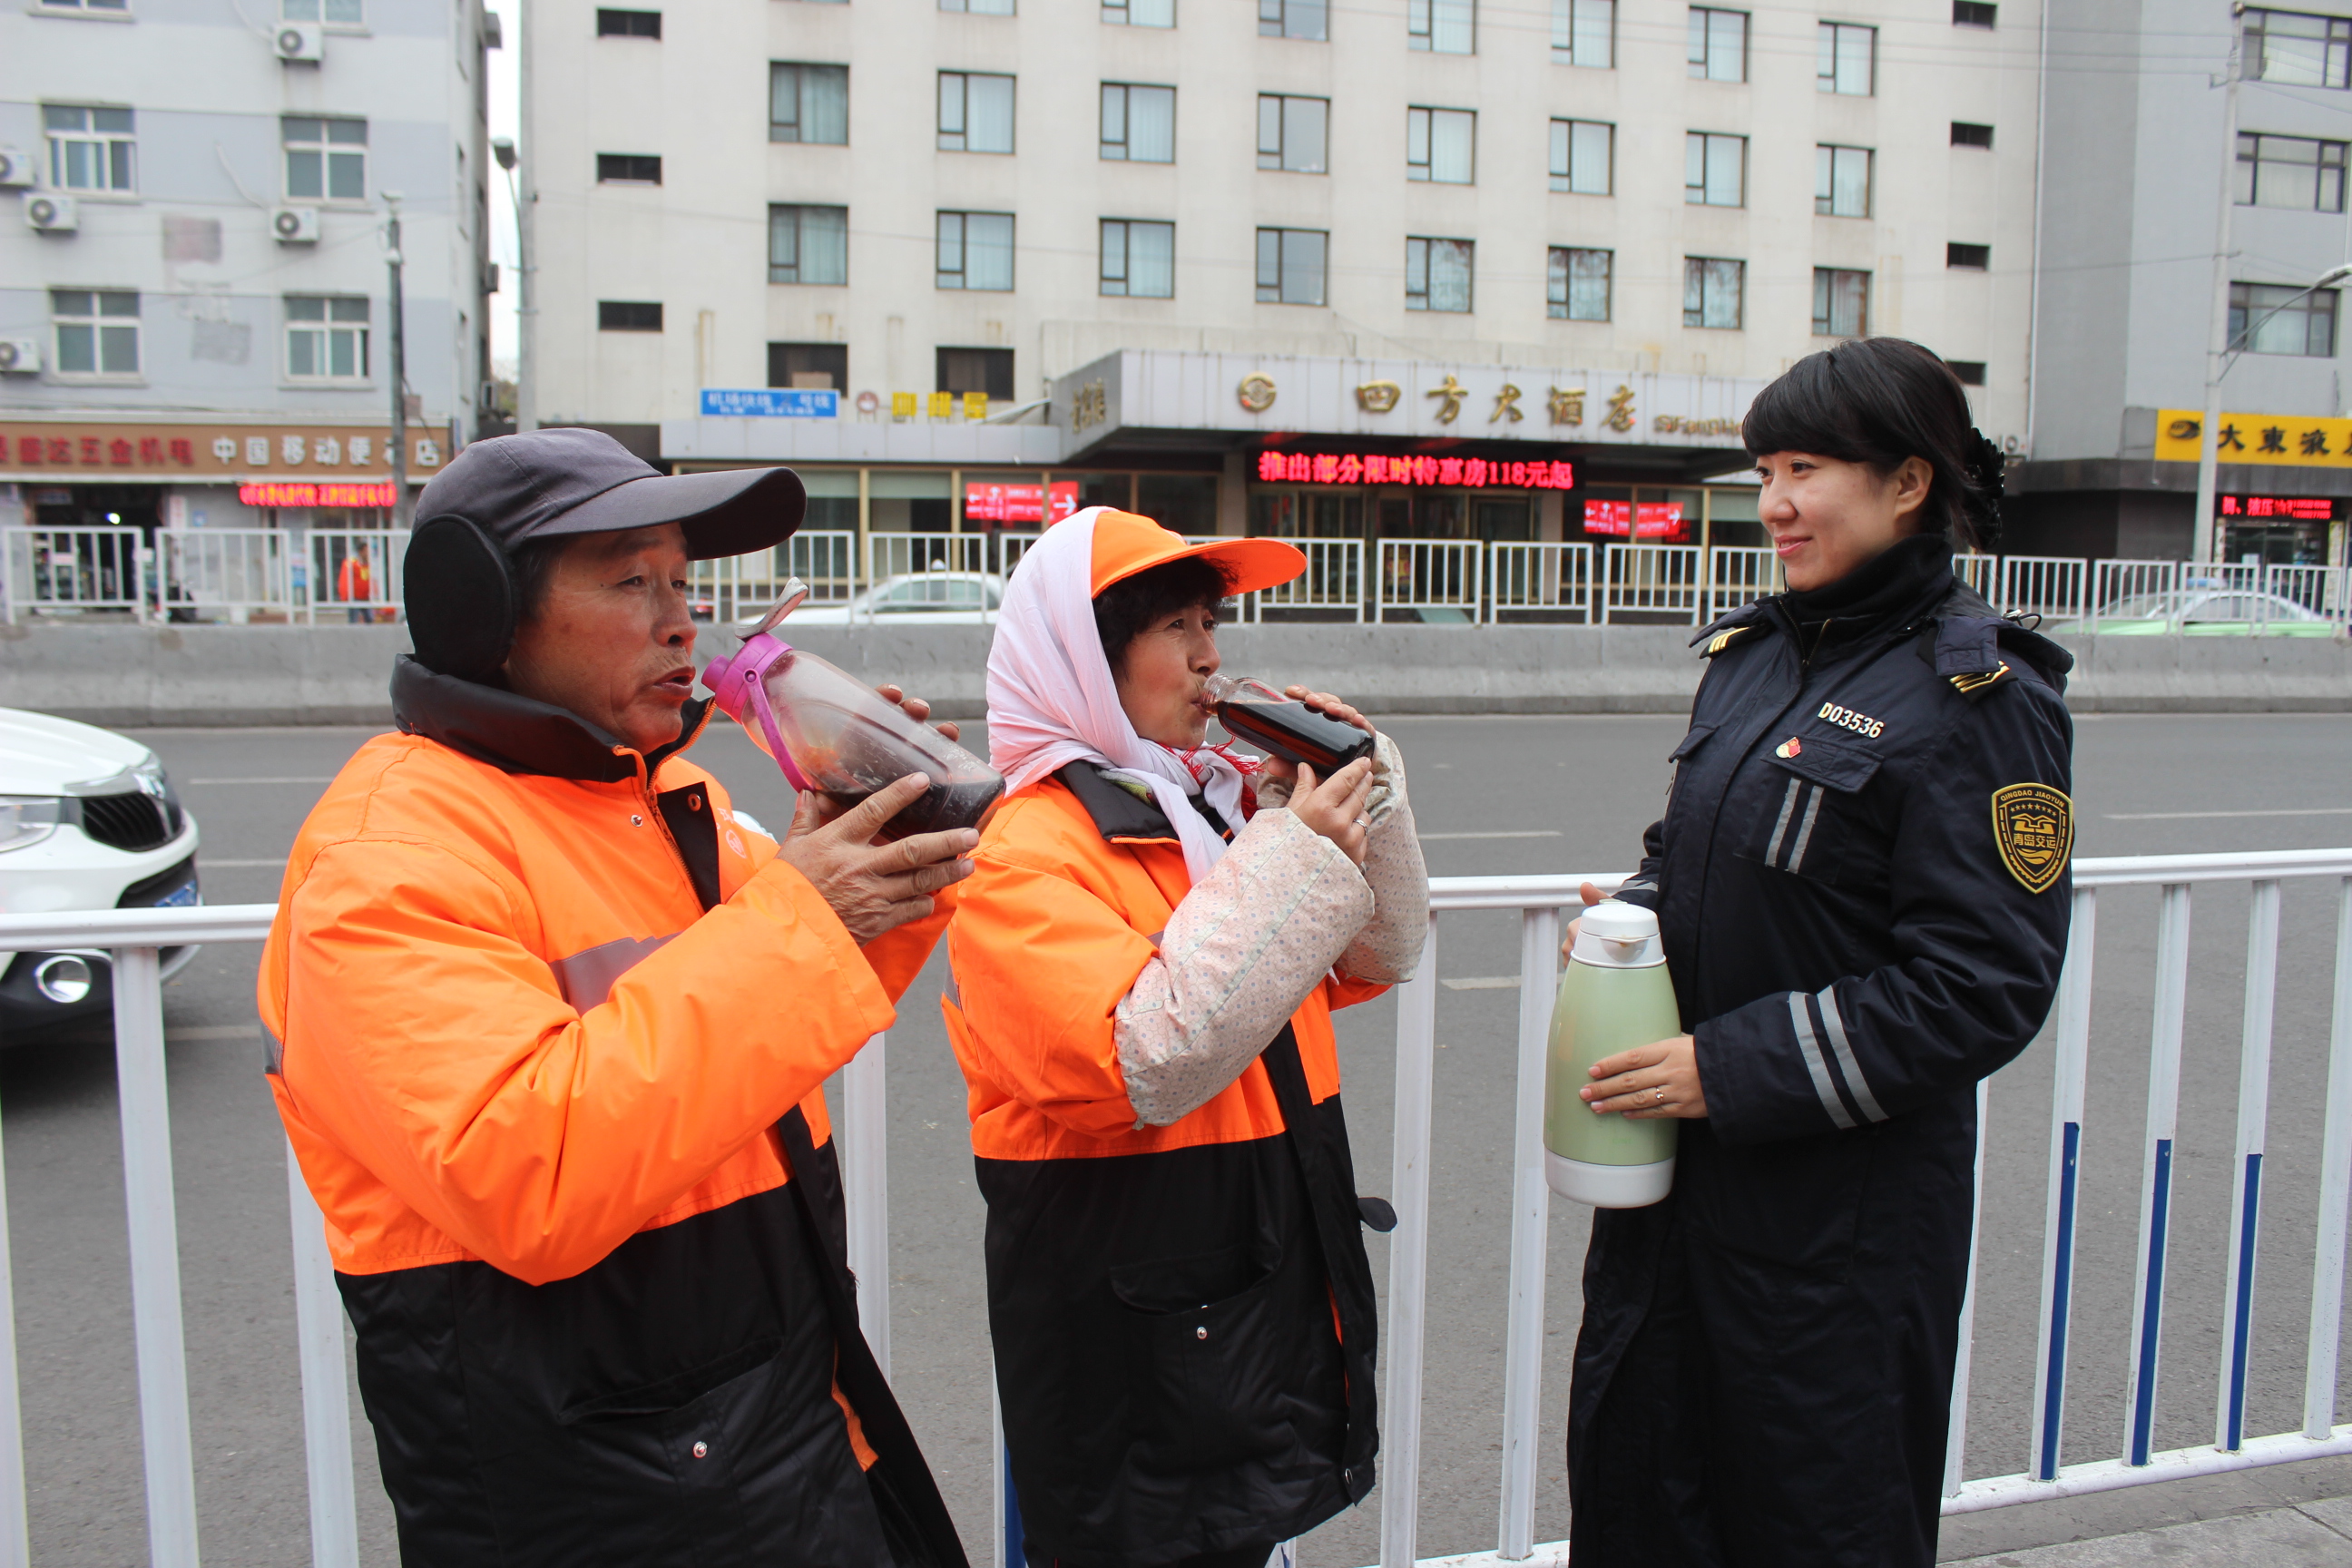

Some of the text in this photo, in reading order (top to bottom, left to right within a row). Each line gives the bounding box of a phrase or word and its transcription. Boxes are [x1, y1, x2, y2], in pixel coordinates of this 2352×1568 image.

[1356, 373, 1637, 433] 四方大酒店
[1258, 450, 1574, 490] 推出部分限时特惠房118元起
[1817, 701, 1885, 739] D03536
[2000, 789, 2065, 808] QINGDAO JIAOYUN
[2013, 832, 2057, 849] 青岛交运
